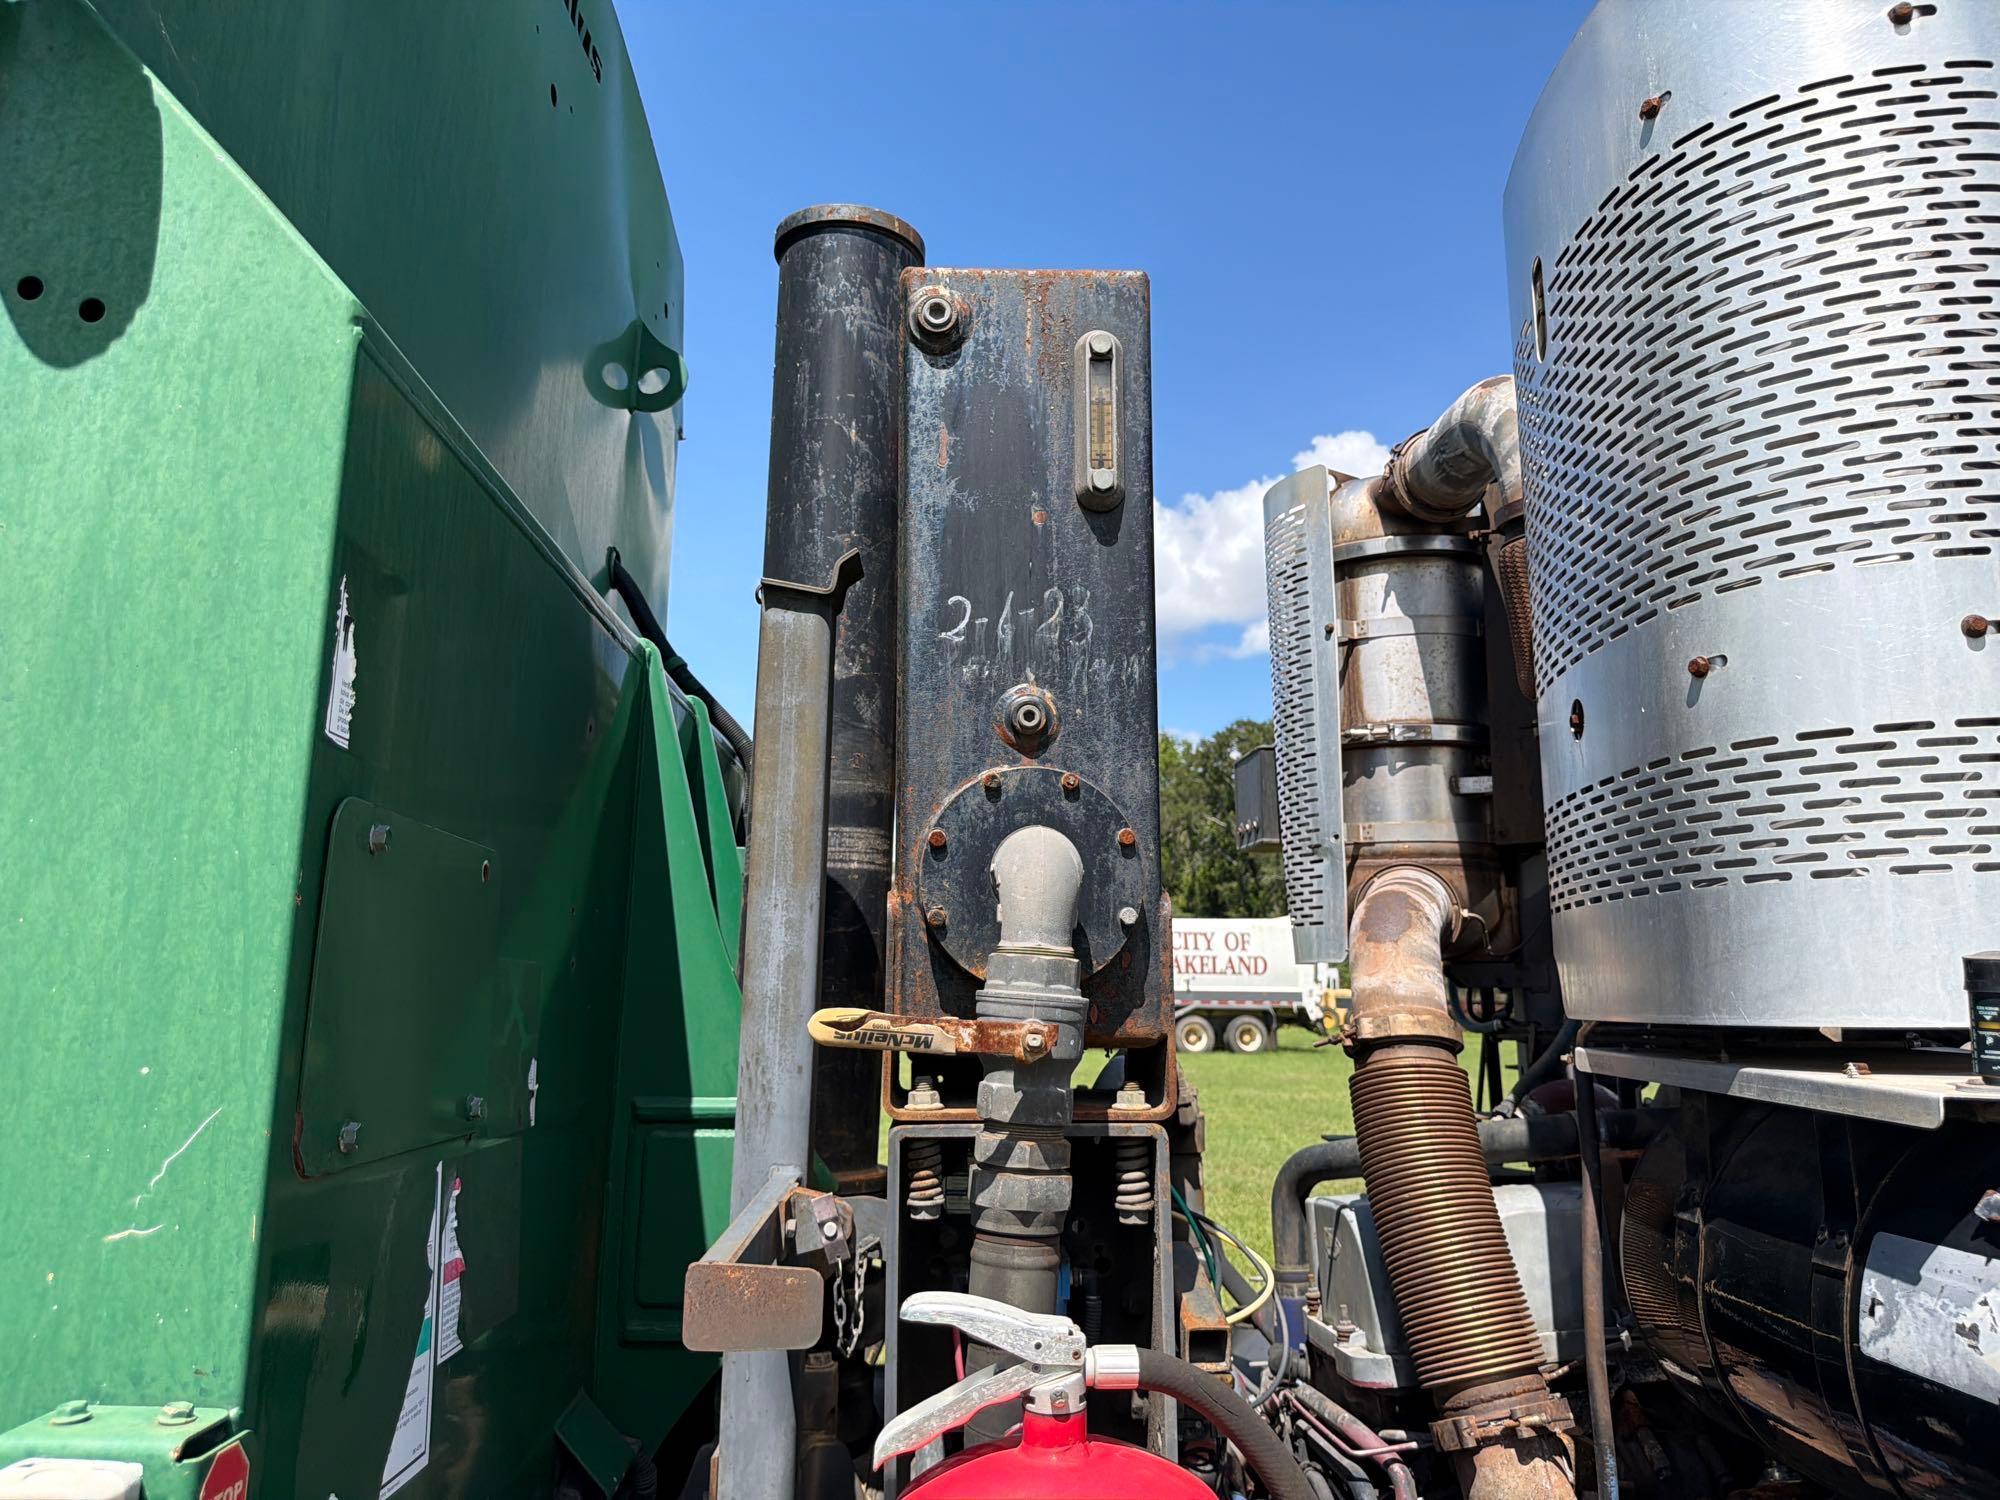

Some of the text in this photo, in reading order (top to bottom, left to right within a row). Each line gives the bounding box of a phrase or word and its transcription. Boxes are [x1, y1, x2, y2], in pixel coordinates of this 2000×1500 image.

[1172, 931, 1251, 951] CITY OF
[1173, 955, 1268, 976] AKELAND
[834, 1031, 934, 1049] McNeilus
